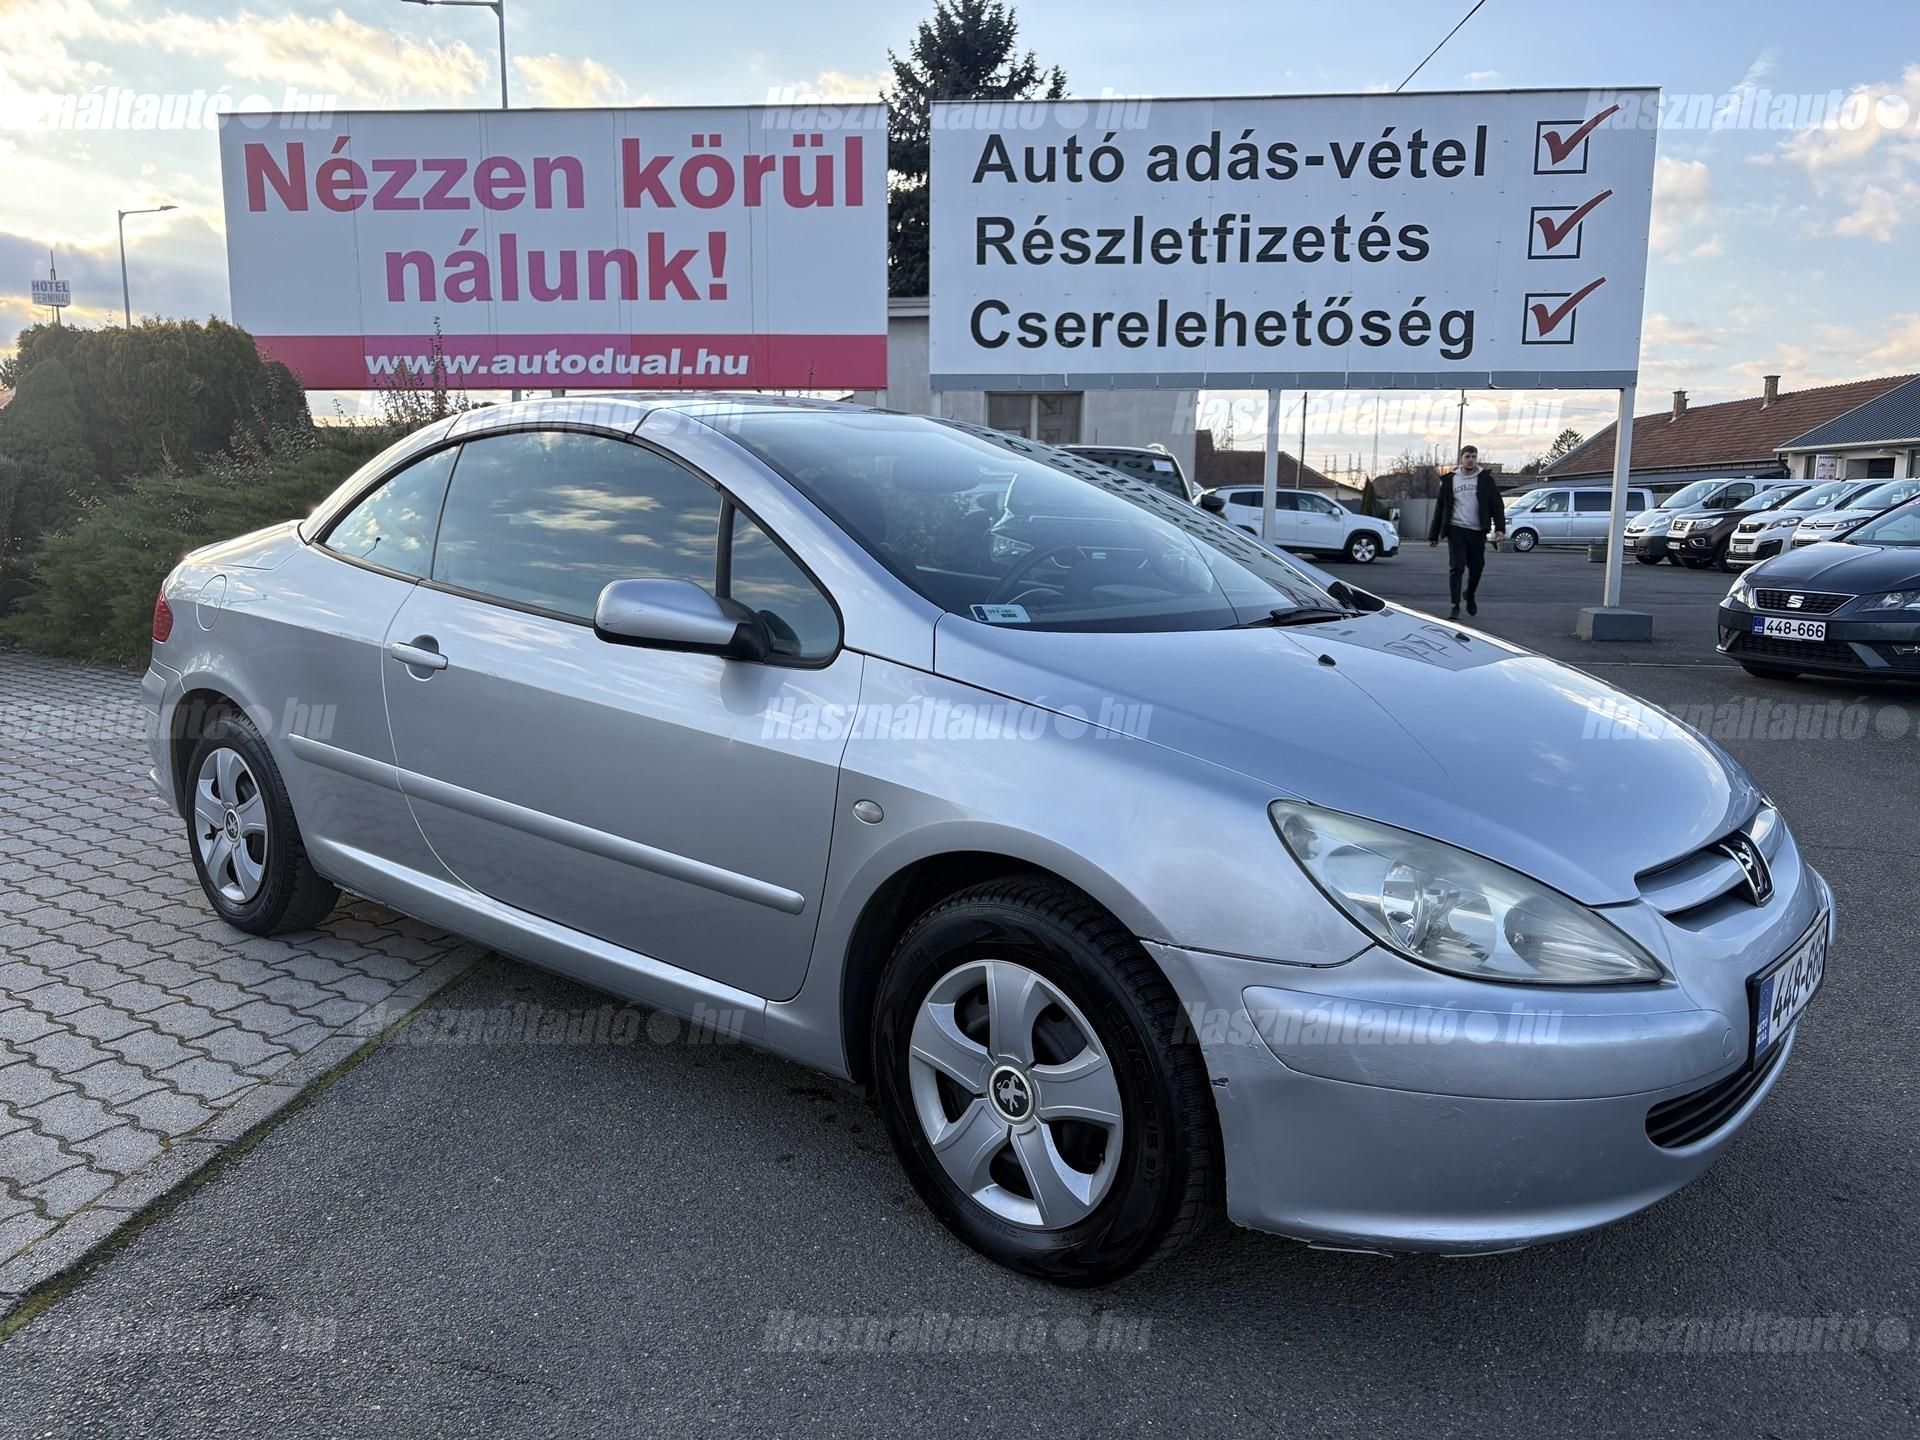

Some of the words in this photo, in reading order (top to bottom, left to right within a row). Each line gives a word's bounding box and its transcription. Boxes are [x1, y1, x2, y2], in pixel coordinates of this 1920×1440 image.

[244, 136, 585, 212] Nézzen
[621, 133, 865, 209] körül
[972, 132, 1125, 184] Autó
[1146, 124, 1488, 182] adás-vétel
[385, 228, 728, 303] nálunk!
[975, 211, 1430, 265] Részletfizetés
[32, 281, 69, 292] HOTEL
[970, 296, 1476, 359] Cserelehetőség
[365, 348, 750, 378] www.autodual.hu
[1766, 621, 1825, 638] 448-666
